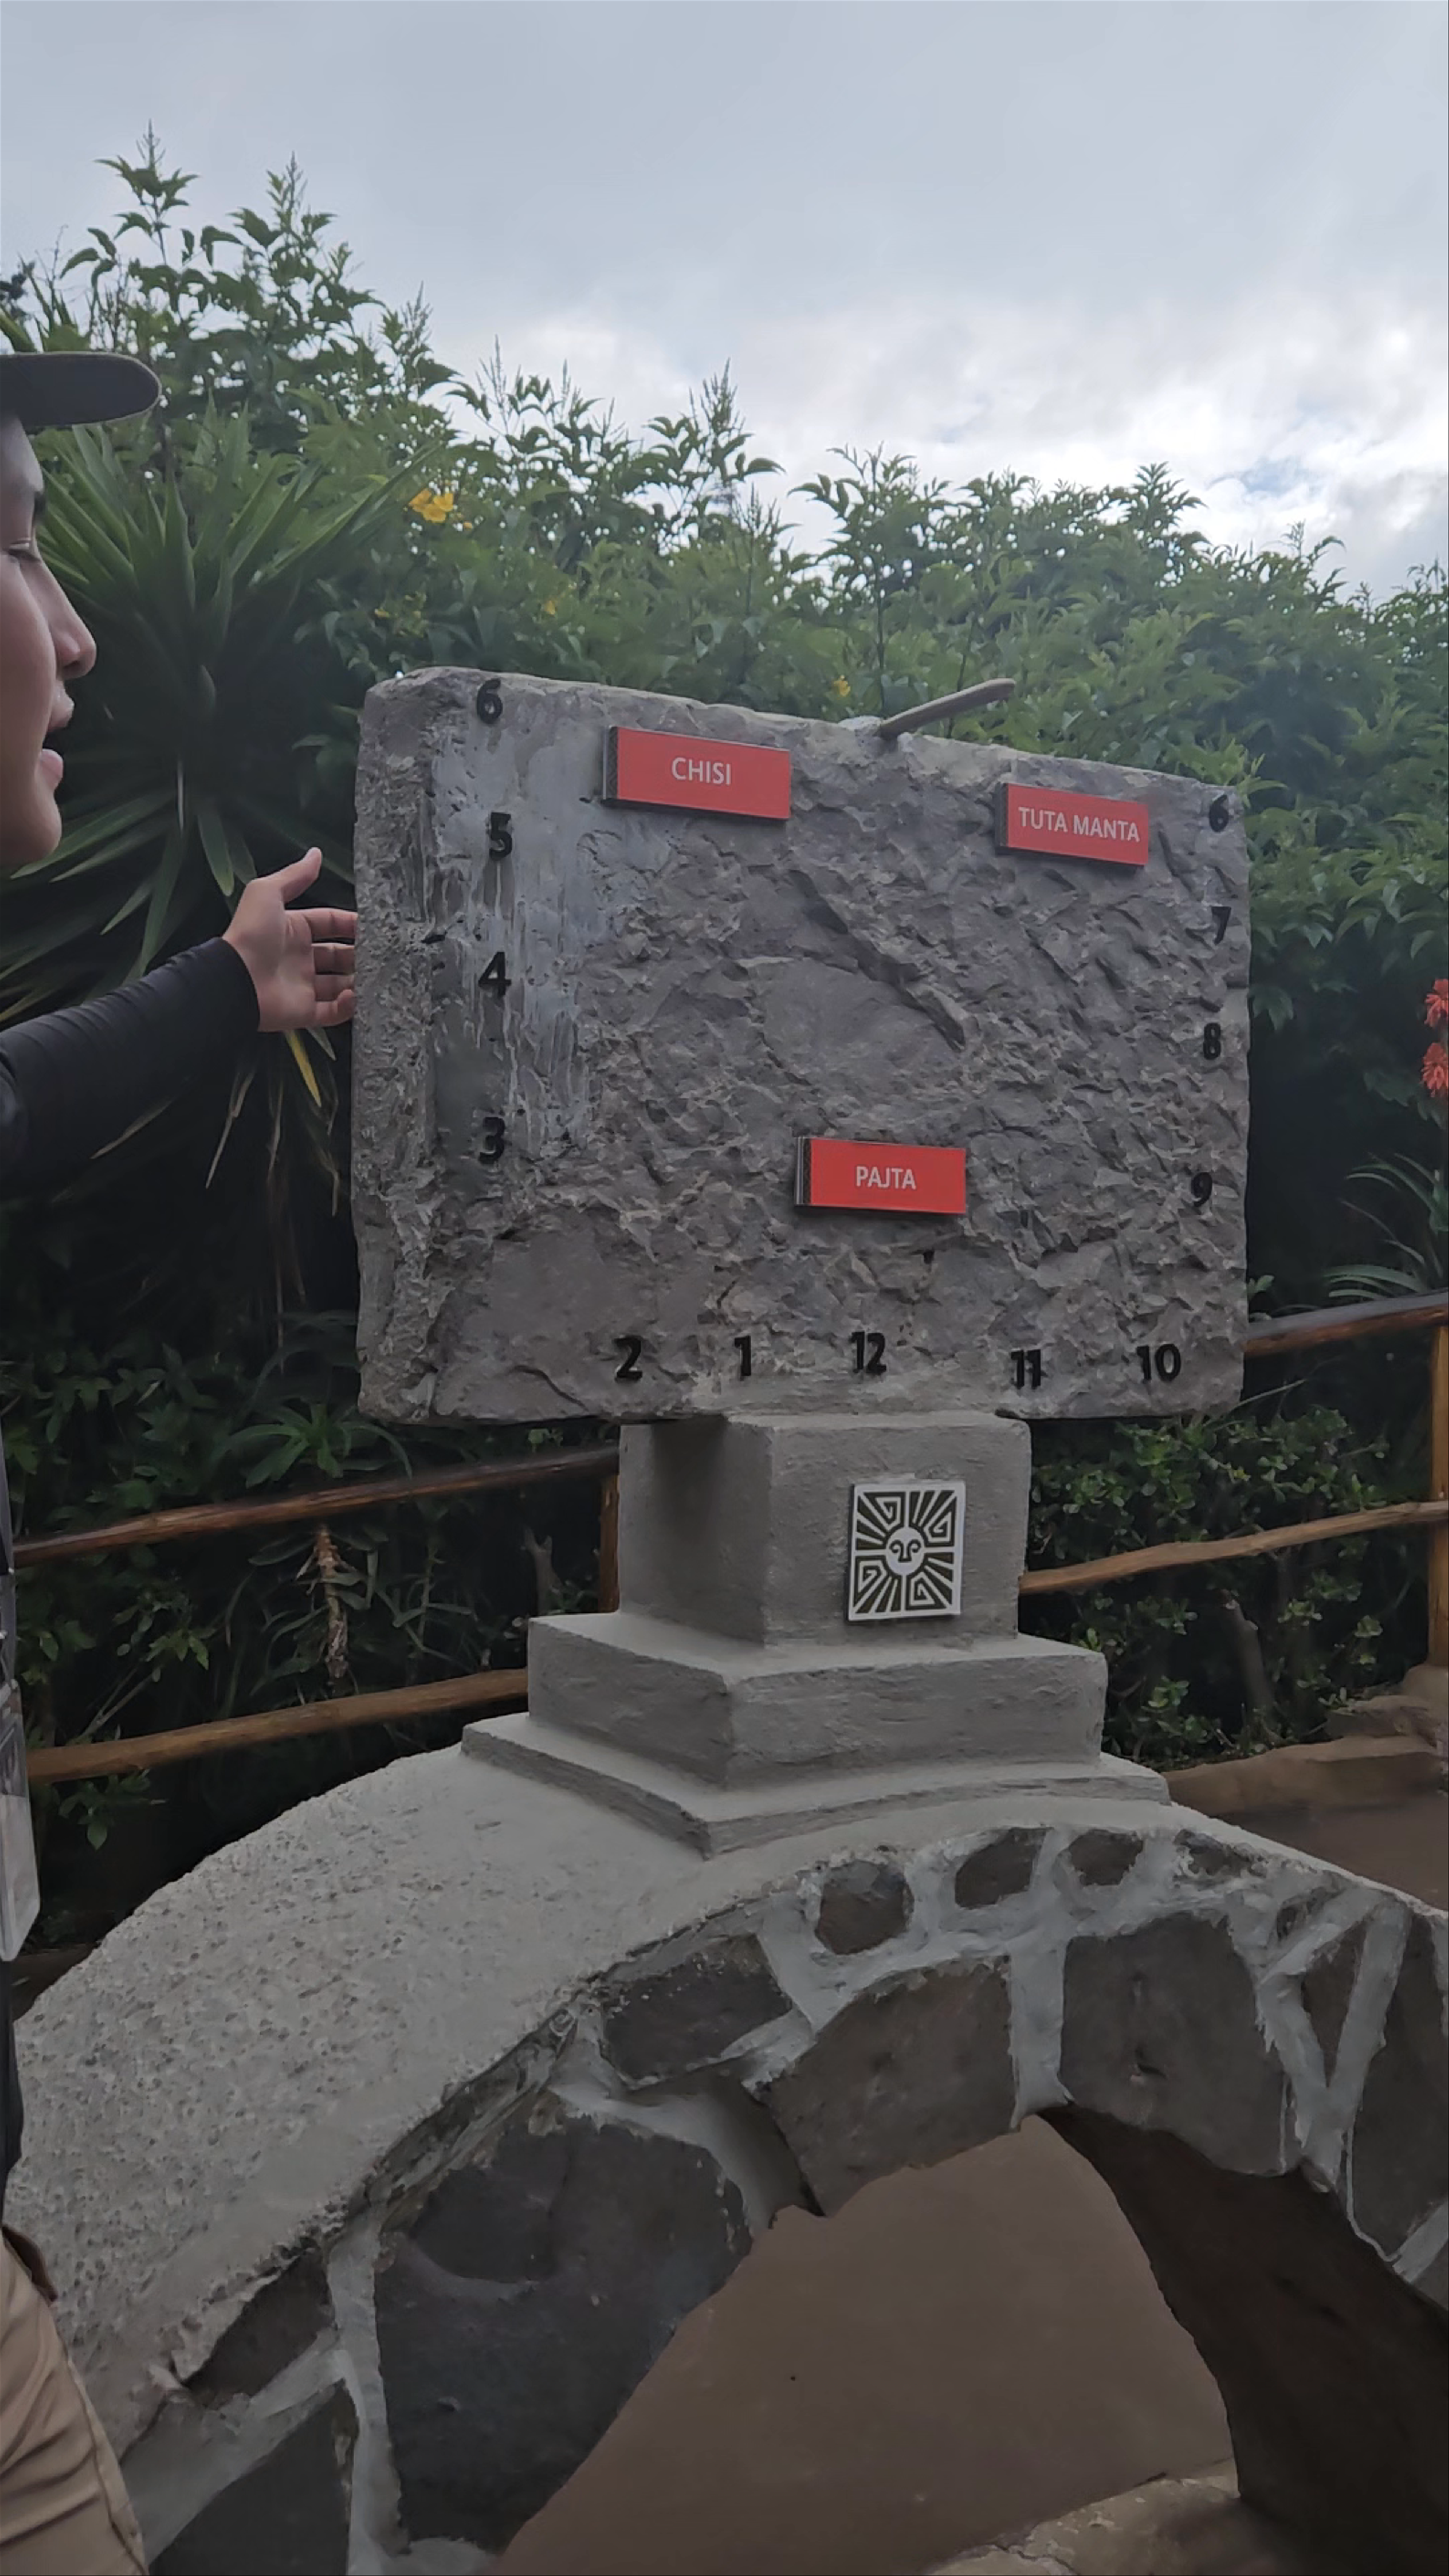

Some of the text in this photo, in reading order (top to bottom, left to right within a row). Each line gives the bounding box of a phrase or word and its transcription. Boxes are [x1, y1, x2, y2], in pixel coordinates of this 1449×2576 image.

[476, 678, 503, 725] 6
[671, 756, 731, 786] CHISI
[1018, 806, 1140, 843] TUTA MANTA
[1209, 794, 1229, 833] 6
[489, 812, 512, 861] 5
[1211, 906, 1232, 946] 7
[478, 951, 511, 997] 4
[1203, 1022, 1221, 1060] 8
[479, 1117, 505, 1164] 3
[856, 1166, 917, 1190] PAJTA
[1191, 1172, 1213, 1207] 9
[613, 1336, 643, 1380] 2
[734, 1335, 751, 1377] 1
[849, 1330, 887, 1375] 12
[1010, 1349, 1041, 1390] 11
[1136, 1343, 1181, 1383] 10
